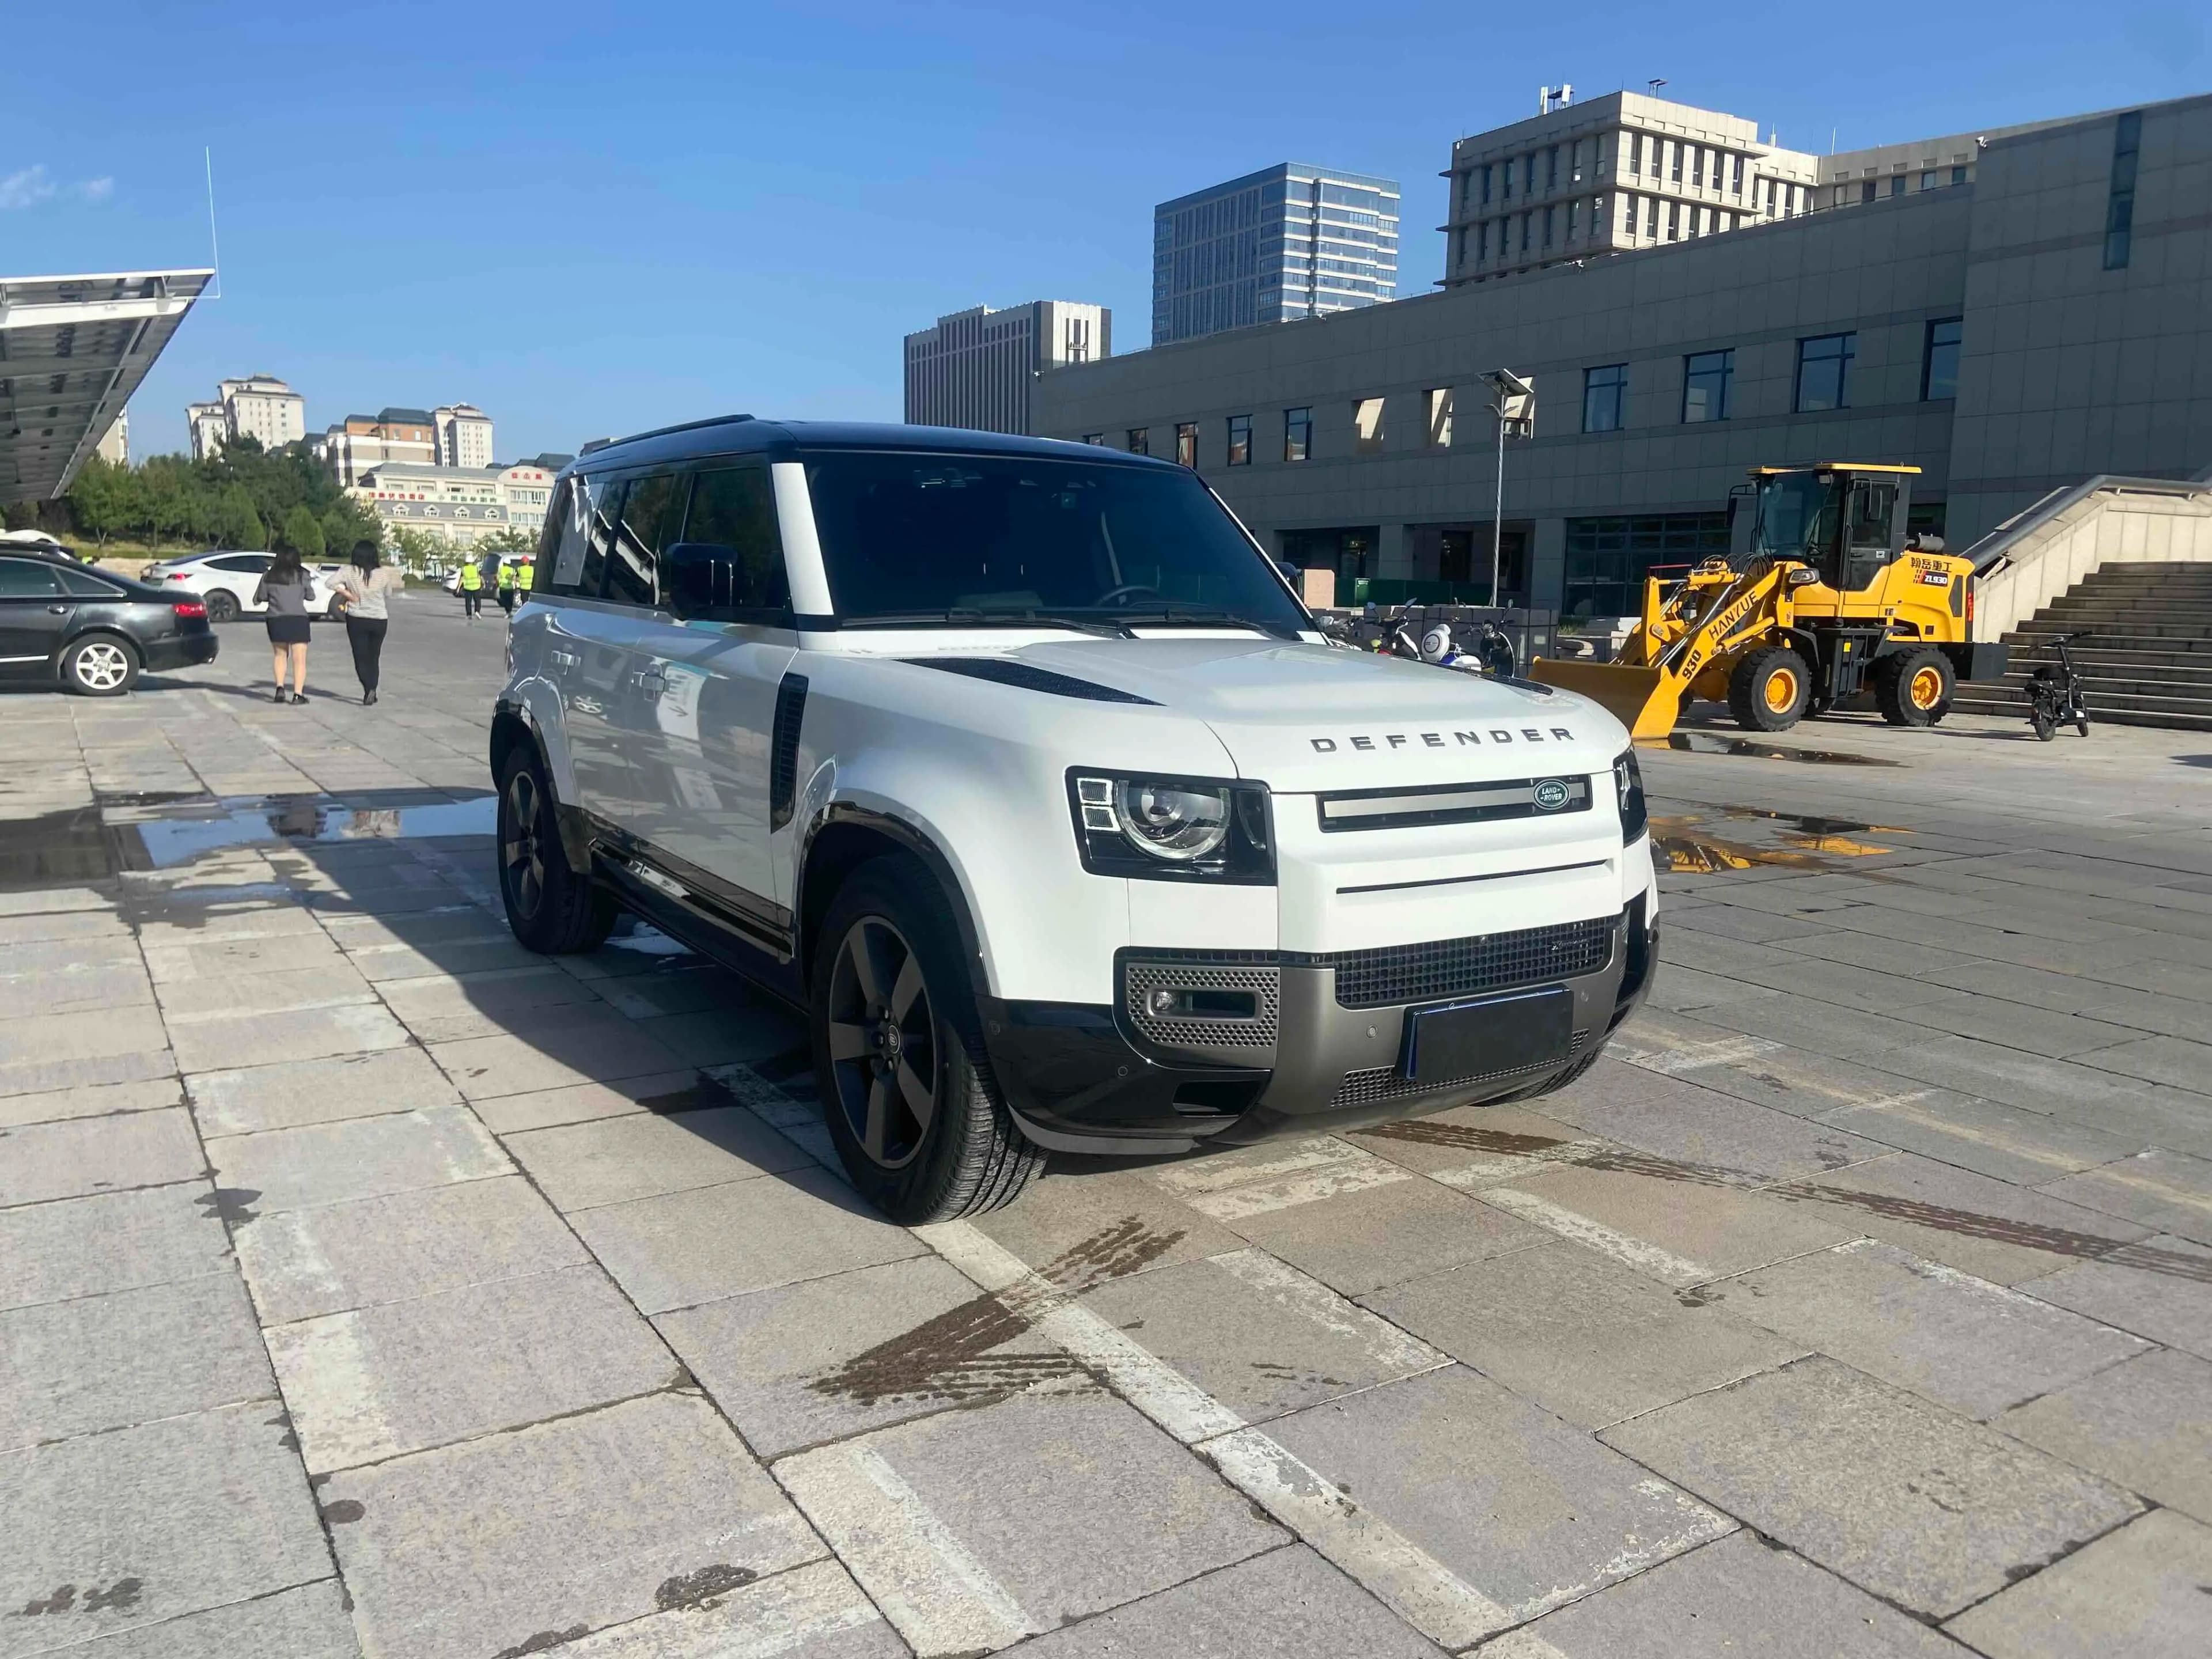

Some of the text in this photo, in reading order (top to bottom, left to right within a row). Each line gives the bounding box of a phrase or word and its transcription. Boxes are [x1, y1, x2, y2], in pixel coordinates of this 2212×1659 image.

[1925, 575, 1948, 584] ZL930
[1708, 590, 1757, 641] HANYUE
[1681, 649, 1702, 680] 930
[1310, 728, 1575, 753] DEFENDER
[1544, 793, 1562, 801] ROVER
